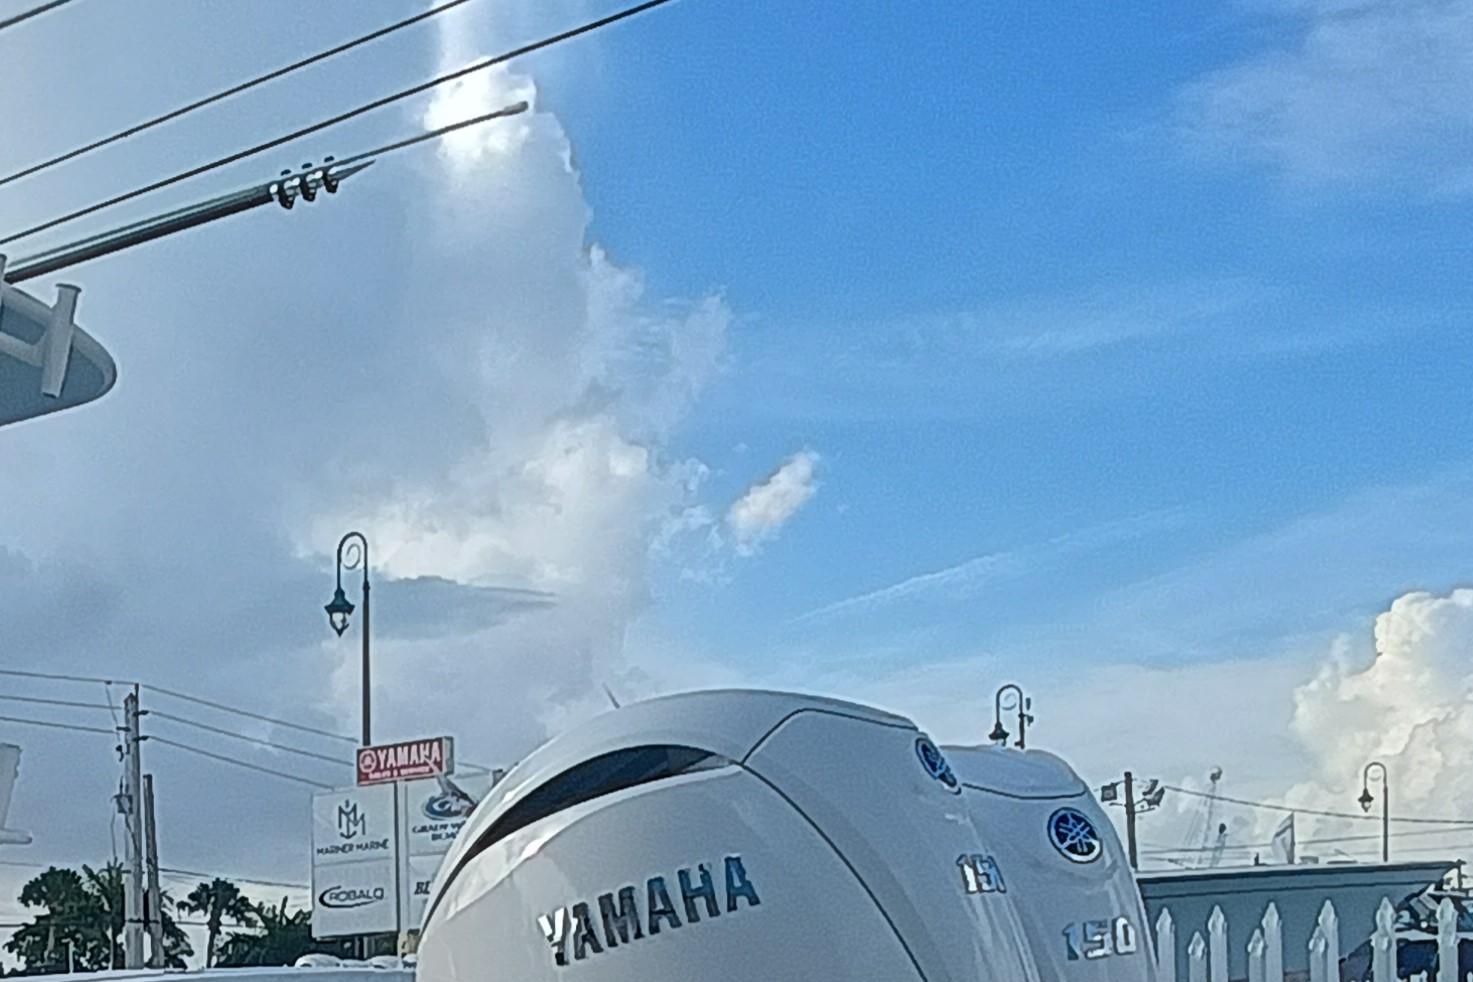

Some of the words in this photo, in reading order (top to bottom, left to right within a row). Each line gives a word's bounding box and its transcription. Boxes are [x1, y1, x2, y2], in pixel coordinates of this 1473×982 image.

[377, 741, 441, 770] YAMAHA
[356, 838, 389, 850] MARINE
[329, 887, 385, 902] ROBALO
[536, 853, 760, 966] YAMAHA
[1063, 916, 1137, 960] 150
